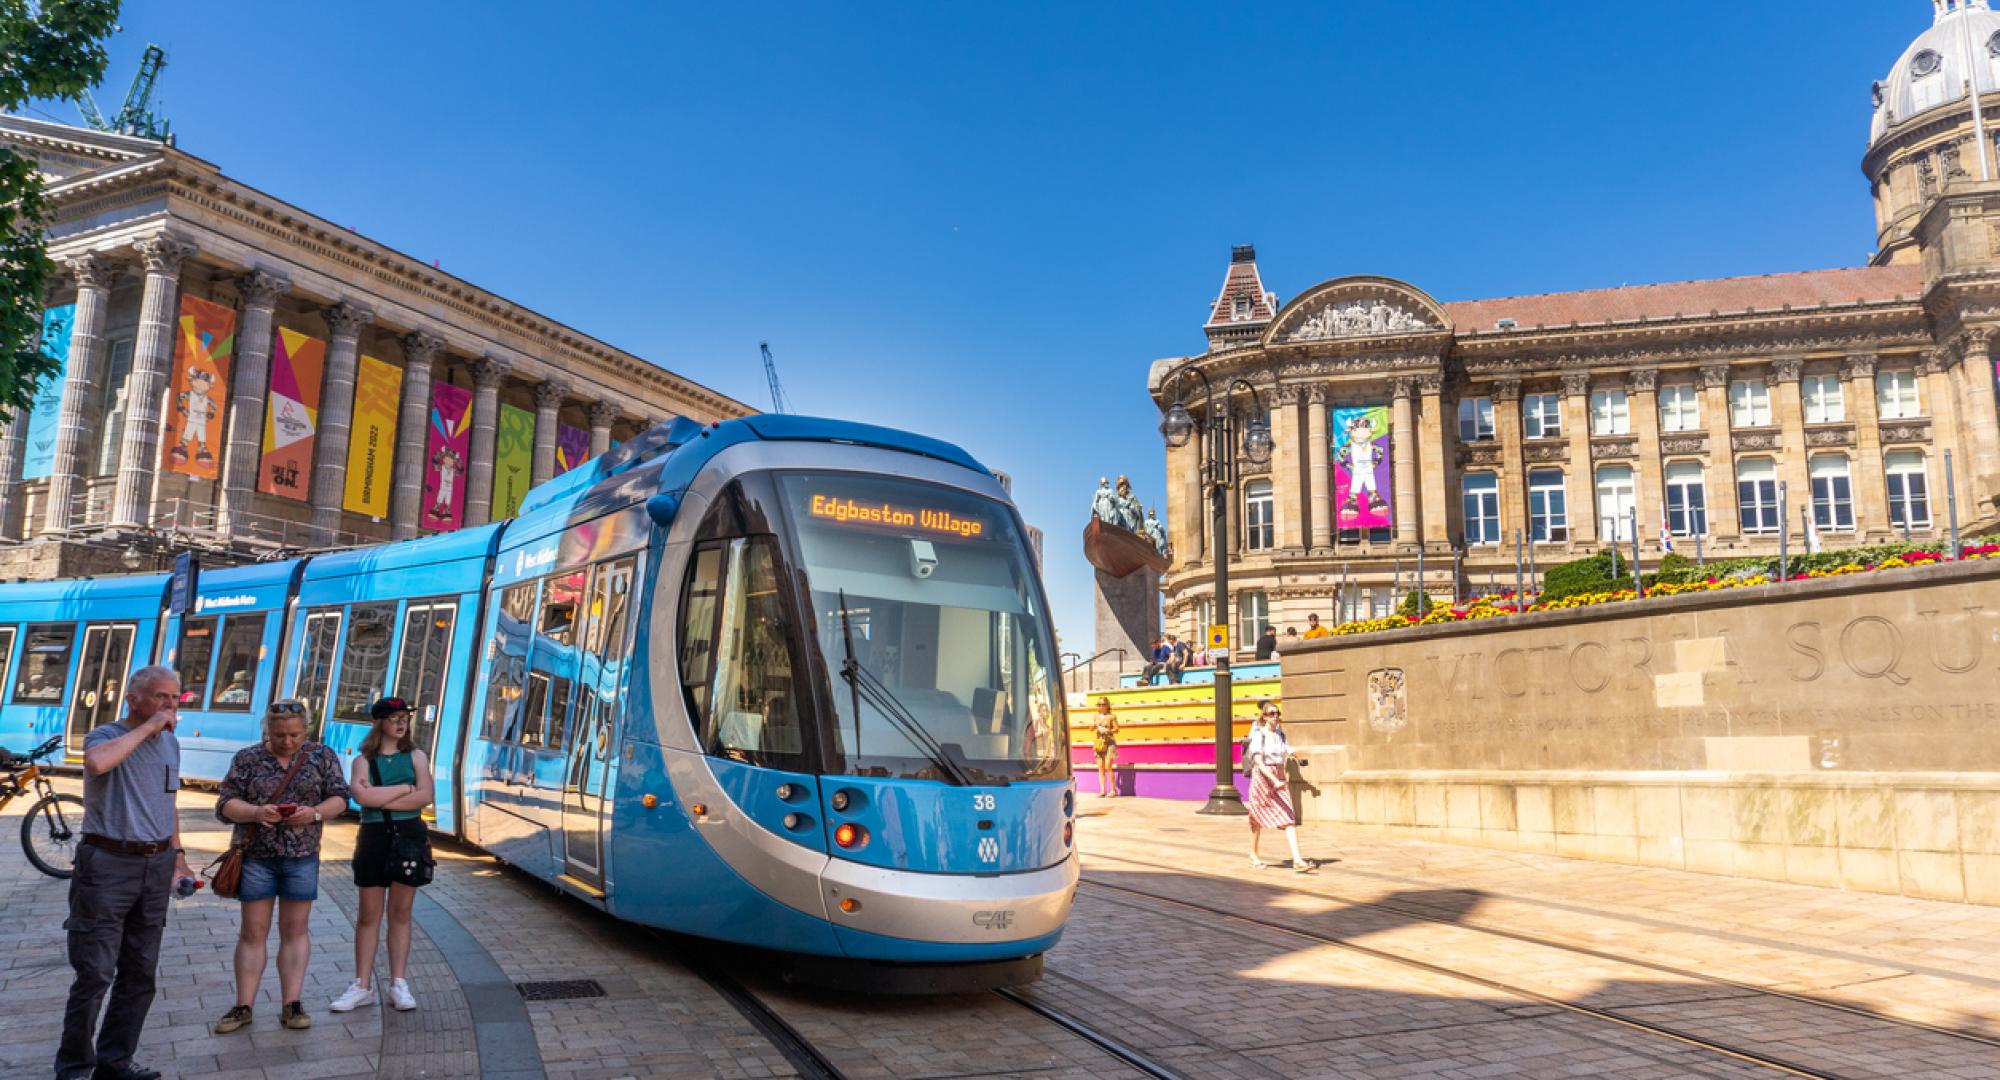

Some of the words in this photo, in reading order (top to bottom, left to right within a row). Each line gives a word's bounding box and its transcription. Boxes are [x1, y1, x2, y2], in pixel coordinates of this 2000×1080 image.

[368, 424, 379, 448] 2022
[362, 448, 376, 504] BIRMINGHAM
[812, 494, 915, 526] Edgbaston
[920, 508, 982, 537] Village
[1426, 627, 1758, 702] VICTORA
[1785, 604, 2000, 687] SQU
[1911, 704, 1944, 721] ON
[1950, 703, 1997, 719] THE
[973, 794, 996, 811] 38
[972, 910, 1017, 930] CAF
